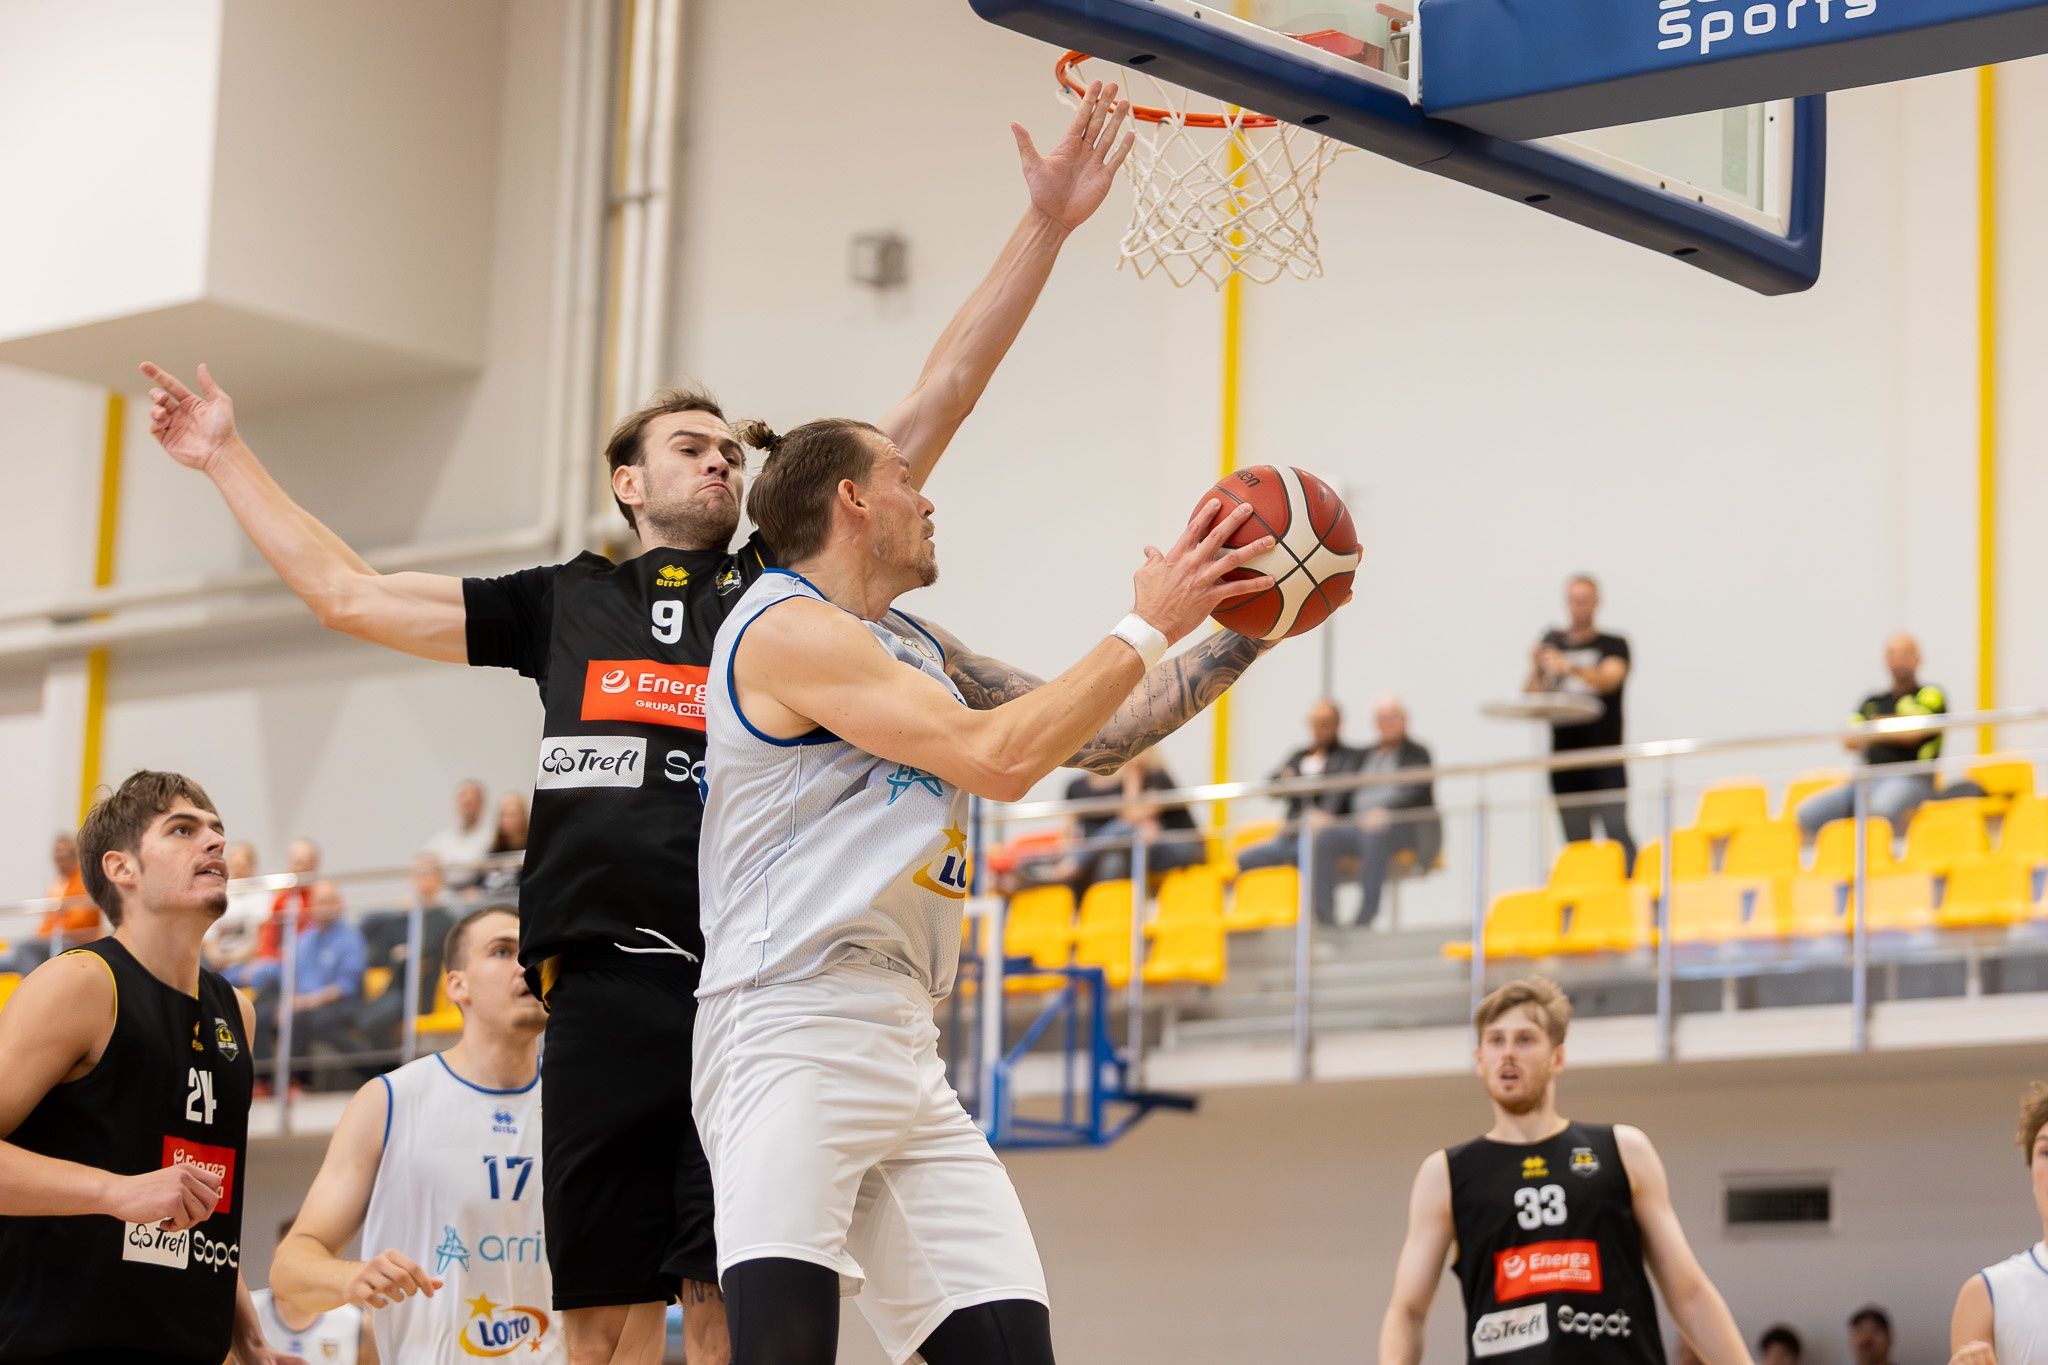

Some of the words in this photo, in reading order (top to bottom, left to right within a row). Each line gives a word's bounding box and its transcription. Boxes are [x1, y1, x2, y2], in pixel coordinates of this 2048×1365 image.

[1657, 0, 1877, 54] Sports
[652, 600, 684, 644] 9
[635, 700, 676, 713] GRUPA
[637, 672, 707, 704] Energ
[577, 748, 639, 776] Trefl
[186, 1067, 217, 1125] 24
[483, 1155, 533, 1201] 17
[1514, 1184, 1567, 1230] 33
[155, 1227, 188, 1258] Trefl
[479, 1230, 541, 1263] arri
[1502, 1315, 1541, 1338] Trefl
[1557, 1304, 1631, 1341] Sopot
